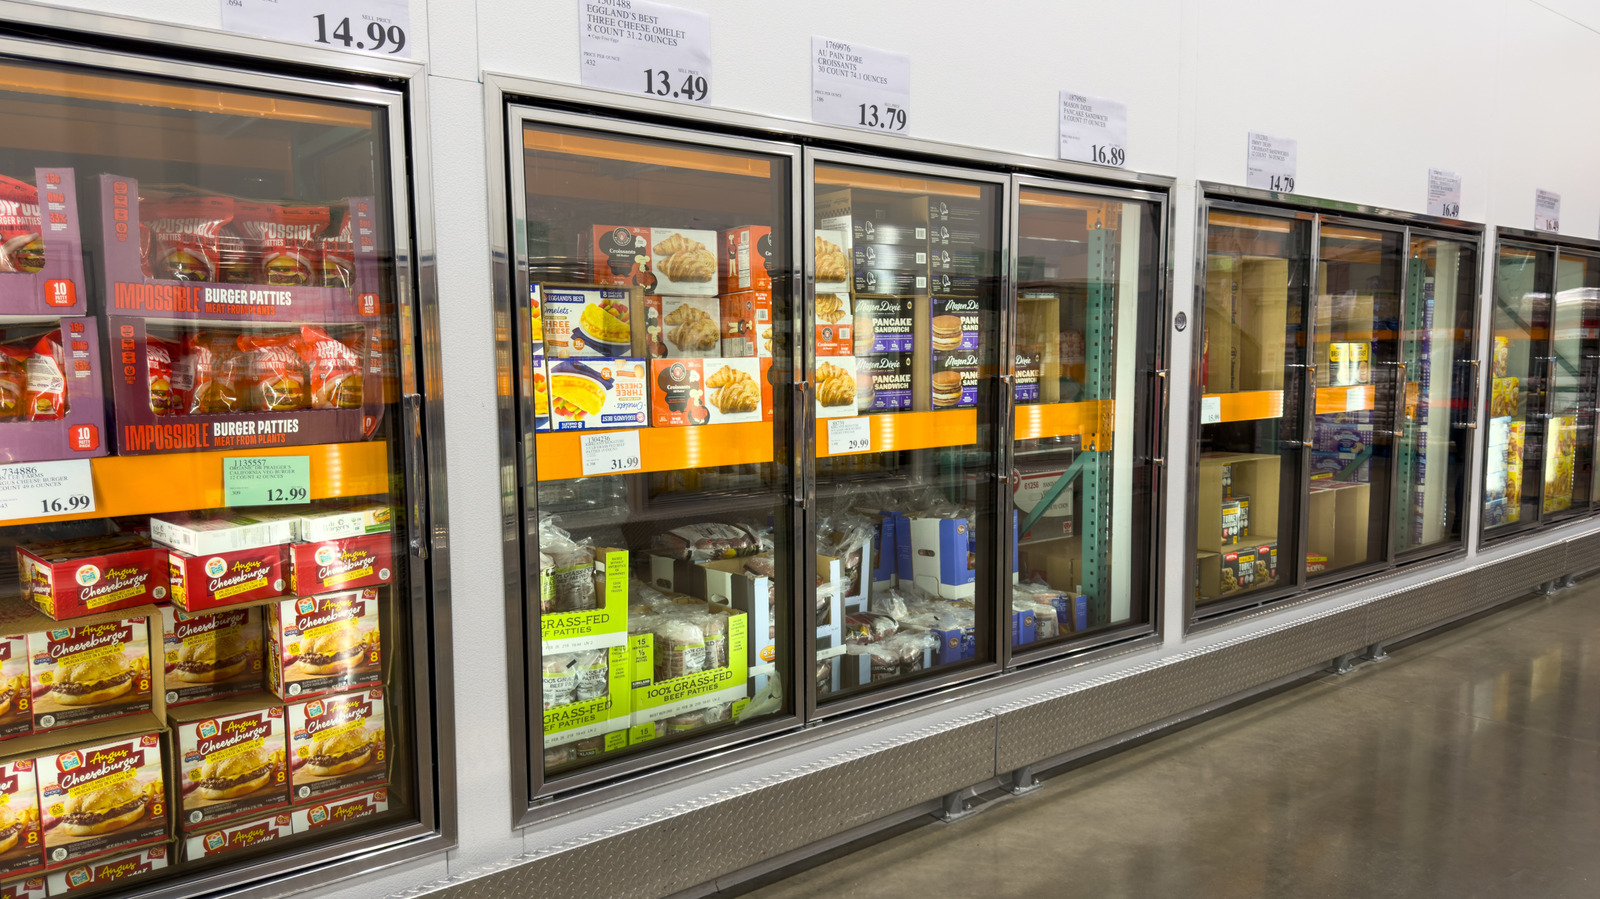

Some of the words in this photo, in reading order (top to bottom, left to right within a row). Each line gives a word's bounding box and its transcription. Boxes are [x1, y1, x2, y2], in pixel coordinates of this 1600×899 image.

[376, 16, 392, 24] PRICE
[586, 4, 637, 21] EGGLAND'S
[638, 13, 659, 25] BEST
[587, 14, 616, 27] THREE
[618, 20, 651, 33] CHEESE
[652, 26, 686, 39] OMELET
[313, 14, 406, 54] 14.99
[594, 25, 625, 38] COUNT
[627, 30, 643, 41] 31.2
[644, 34, 678, 47] OUNCES
[826, 40, 852, 53] 1769976
[818, 49, 828, 57] AU
[829, 51, 844, 60] PAIN
[846, 54, 863, 64] DORE
[818, 57, 857, 71] CROISSANTS
[818, 65, 826, 73] 30
[826, 66, 849, 78] COUNT
[863, 74, 888, 85] OUNCES
[644, 68, 708, 101] 13.49
[1064, 101, 1080, 109] MASON
[859, 103, 907, 130] 13.79
[1064, 108, 1085, 117] PANCAKE
[1085, 112, 1108, 122] SANDWICH
[1067, 116, 1082, 124] COUNT
[1088, 119, 1106, 128] OUNCES
[1092, 144, 1125, 166] 16.89
[1270, 175, 1295, 192] 14.79
[1442, 204, 1460, 217] 16.49
[54, 282, 67, 295] 10
[114, 282, 201, 313] IMPOSSIBLE
[205, 287, 248, 304] BURGER
[250, 290, 292, 306] PATTIES
[364, 296, 373, 306] 10
[548, 294, 572, 302] EGGLAND'S
[573, 294, 584, 302] BEST
[205, 303, 225, 314] MEAT
[227, 304, 248, 314] FROM
[248, 305, 276, 316] PLANTS
[856, 301, 880, 313] Mason
[880, 301, 901, 312] Dixie
[945, 300, 967, 312] Mason
[873, 318, 912, 326] PANCAKE
[74, 360, 91, 371] 33%
[856, 358, 880, 370] Mason
[880, 358, 900, 369] Dixie
[945, 356, 967, 367] Mason
[872, 375, 911, 383] PANCAKE
[617, 402, 643, 410] Omelets
[78, 427, 90, 440] 10
[124, 423, 210, 451] IMPOSSIBLE
[214, 421, 256, 437] BURGER
[258, 419, 299, 434] PATTIES
[214, 436, 234, 447] MEAT
[236, 435, 257, 446] FROM
[258, 433, 286, 444] PLANTS
[849, 439, 869, 449] 29.99
[234, 459, 267, 467] 1135557
[611, 457, 639, 470] 31.99
[268, 488, 307, 501] 12.99
[41, 495, 90, 513] 16.99
[340, 550, 367, 562] Angus
[105, 566, 139, 580] Angus
[231, 560, 262, 572] Angus
[318, 556, 376, 580] Cheeseburger
[209, 565, 270, 592] Cheeseburger
[80, 572, 148, 601] Cheeseburger
[322, 600, 353, 612] Angus
[177, 612, 245, 639] Cheeseburger
[298, 606, 362, 631] Cheeseburger
[541, 613, 610, 630] GRASS-FED
[79, 623, 117, 637] Angus
[554, 626, 592, 636] PATTIES
[51, 629, 128, 658] Cheeseburger
[370, 652, 378, 662] 8
[253, 660, 262, 670] 8
[41, 672, 50, 680] 25
[140, 679, 149, 690] 8
[647, 687, 672, 699] 100%
[674, 671, 733, 692] GRASS-FED
[664, 690, 685, 702] BEEF
[687, 683, 719, 696] PATTIES
[19, 698, 29, 710] 8
[308, 706, 369, 734] Cheeseburger
[543, 701, 612, 725] GRASS-FED
[224, 719, 258, 734] Angus
[558, 714, 596, 729] PATTIES
[200, 724, 268, 756] Cheeseburger
[90, 749, 129, 765] Angus
[377, 750, 384, 760] 8
[62, 754, 140, 790] Cheeseburger
[277, 771, 285, 782] 8
[153, 804, 163, 815] 8
[334, 804, 364, 819] Angus
[27, 832, 38, 843] 8
[232, 827, 265, 844] Angus
[99, 861, 137, 879] Angus
